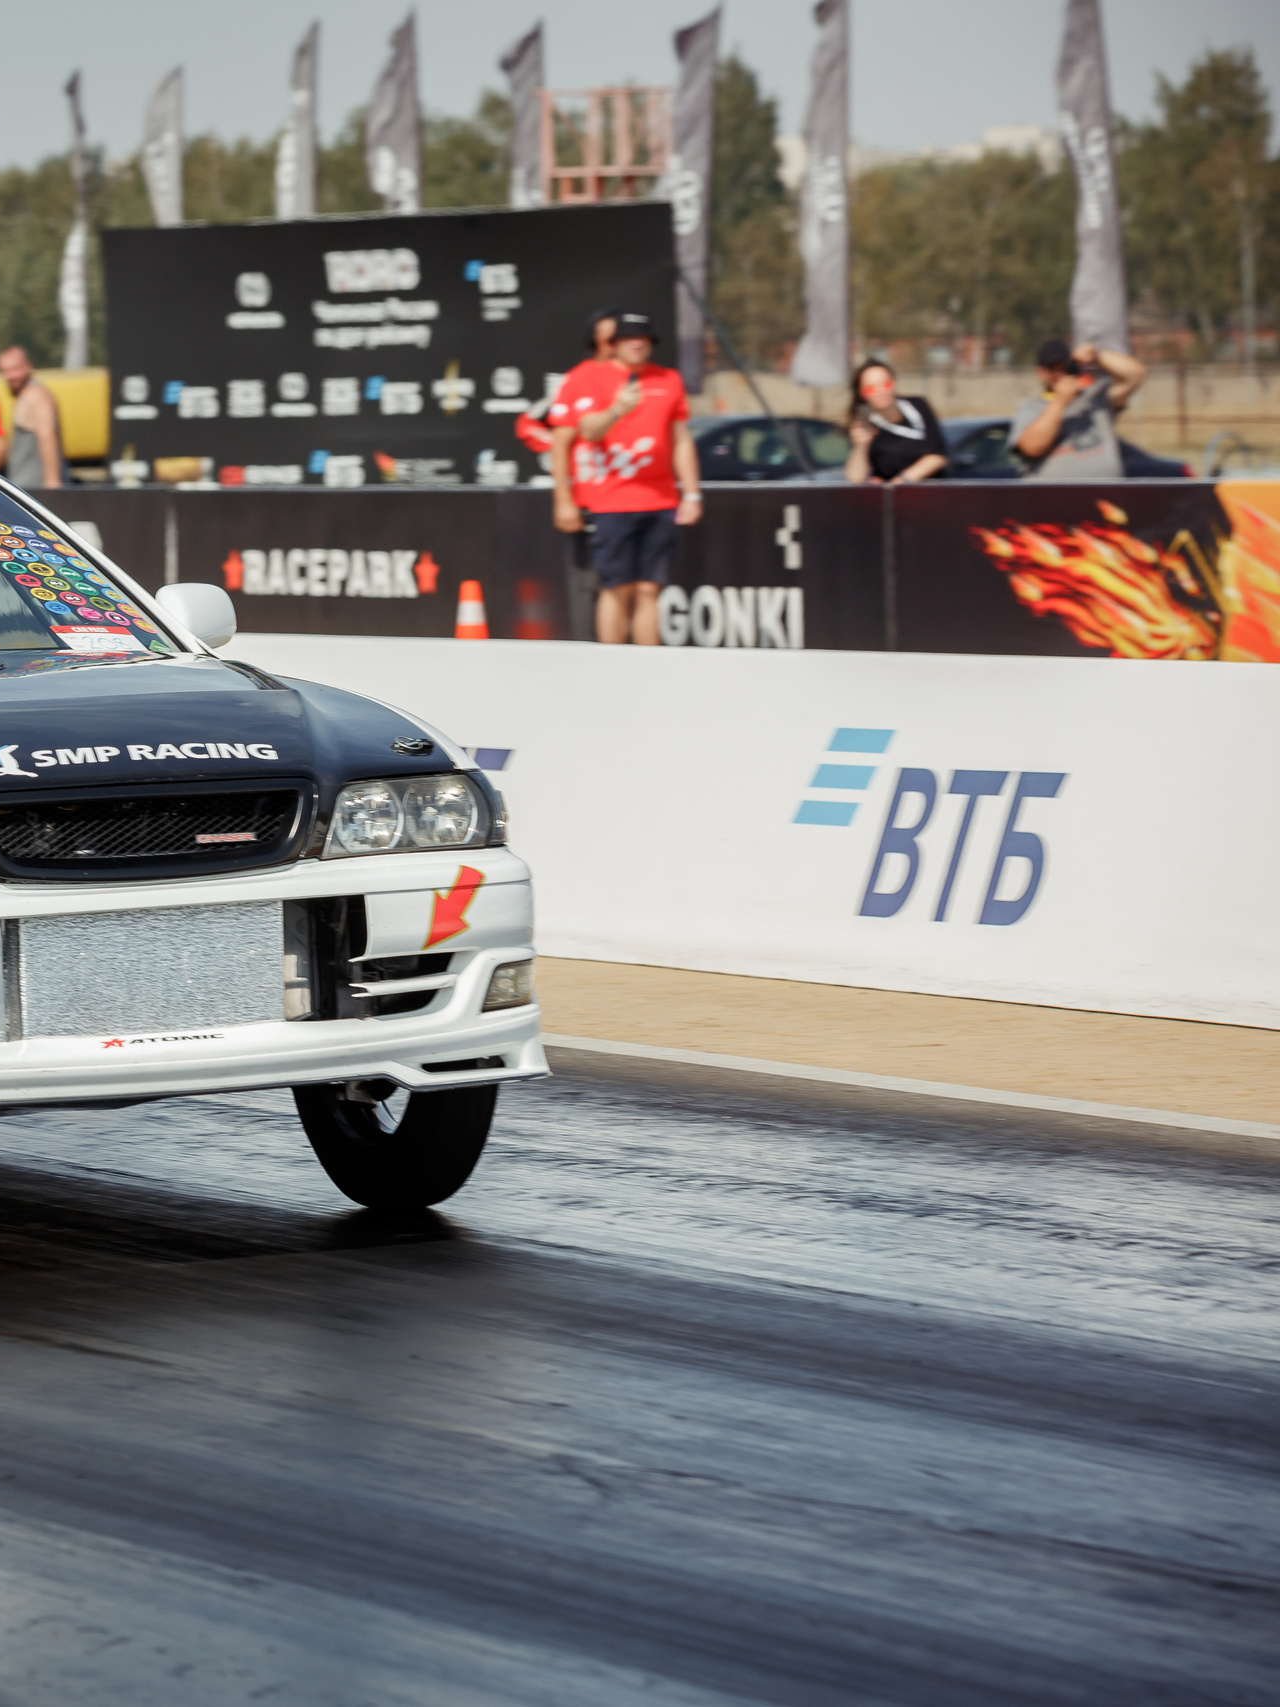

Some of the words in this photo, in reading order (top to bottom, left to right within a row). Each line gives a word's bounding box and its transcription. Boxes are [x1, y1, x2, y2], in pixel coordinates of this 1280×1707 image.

[241, 548, 419, 598] RACEPARK
[657, 584, 805, 648] GONKI
[82, 635, 133, 650] 208
[30, 747, 120, 767] SMP
[126, 742, 279, 761] RACING
[196, 833, 255, 844] CHASER
[857, 766, 1070, 927] ВТБ
[129, 1033, 224, 1044] ATOMIC
